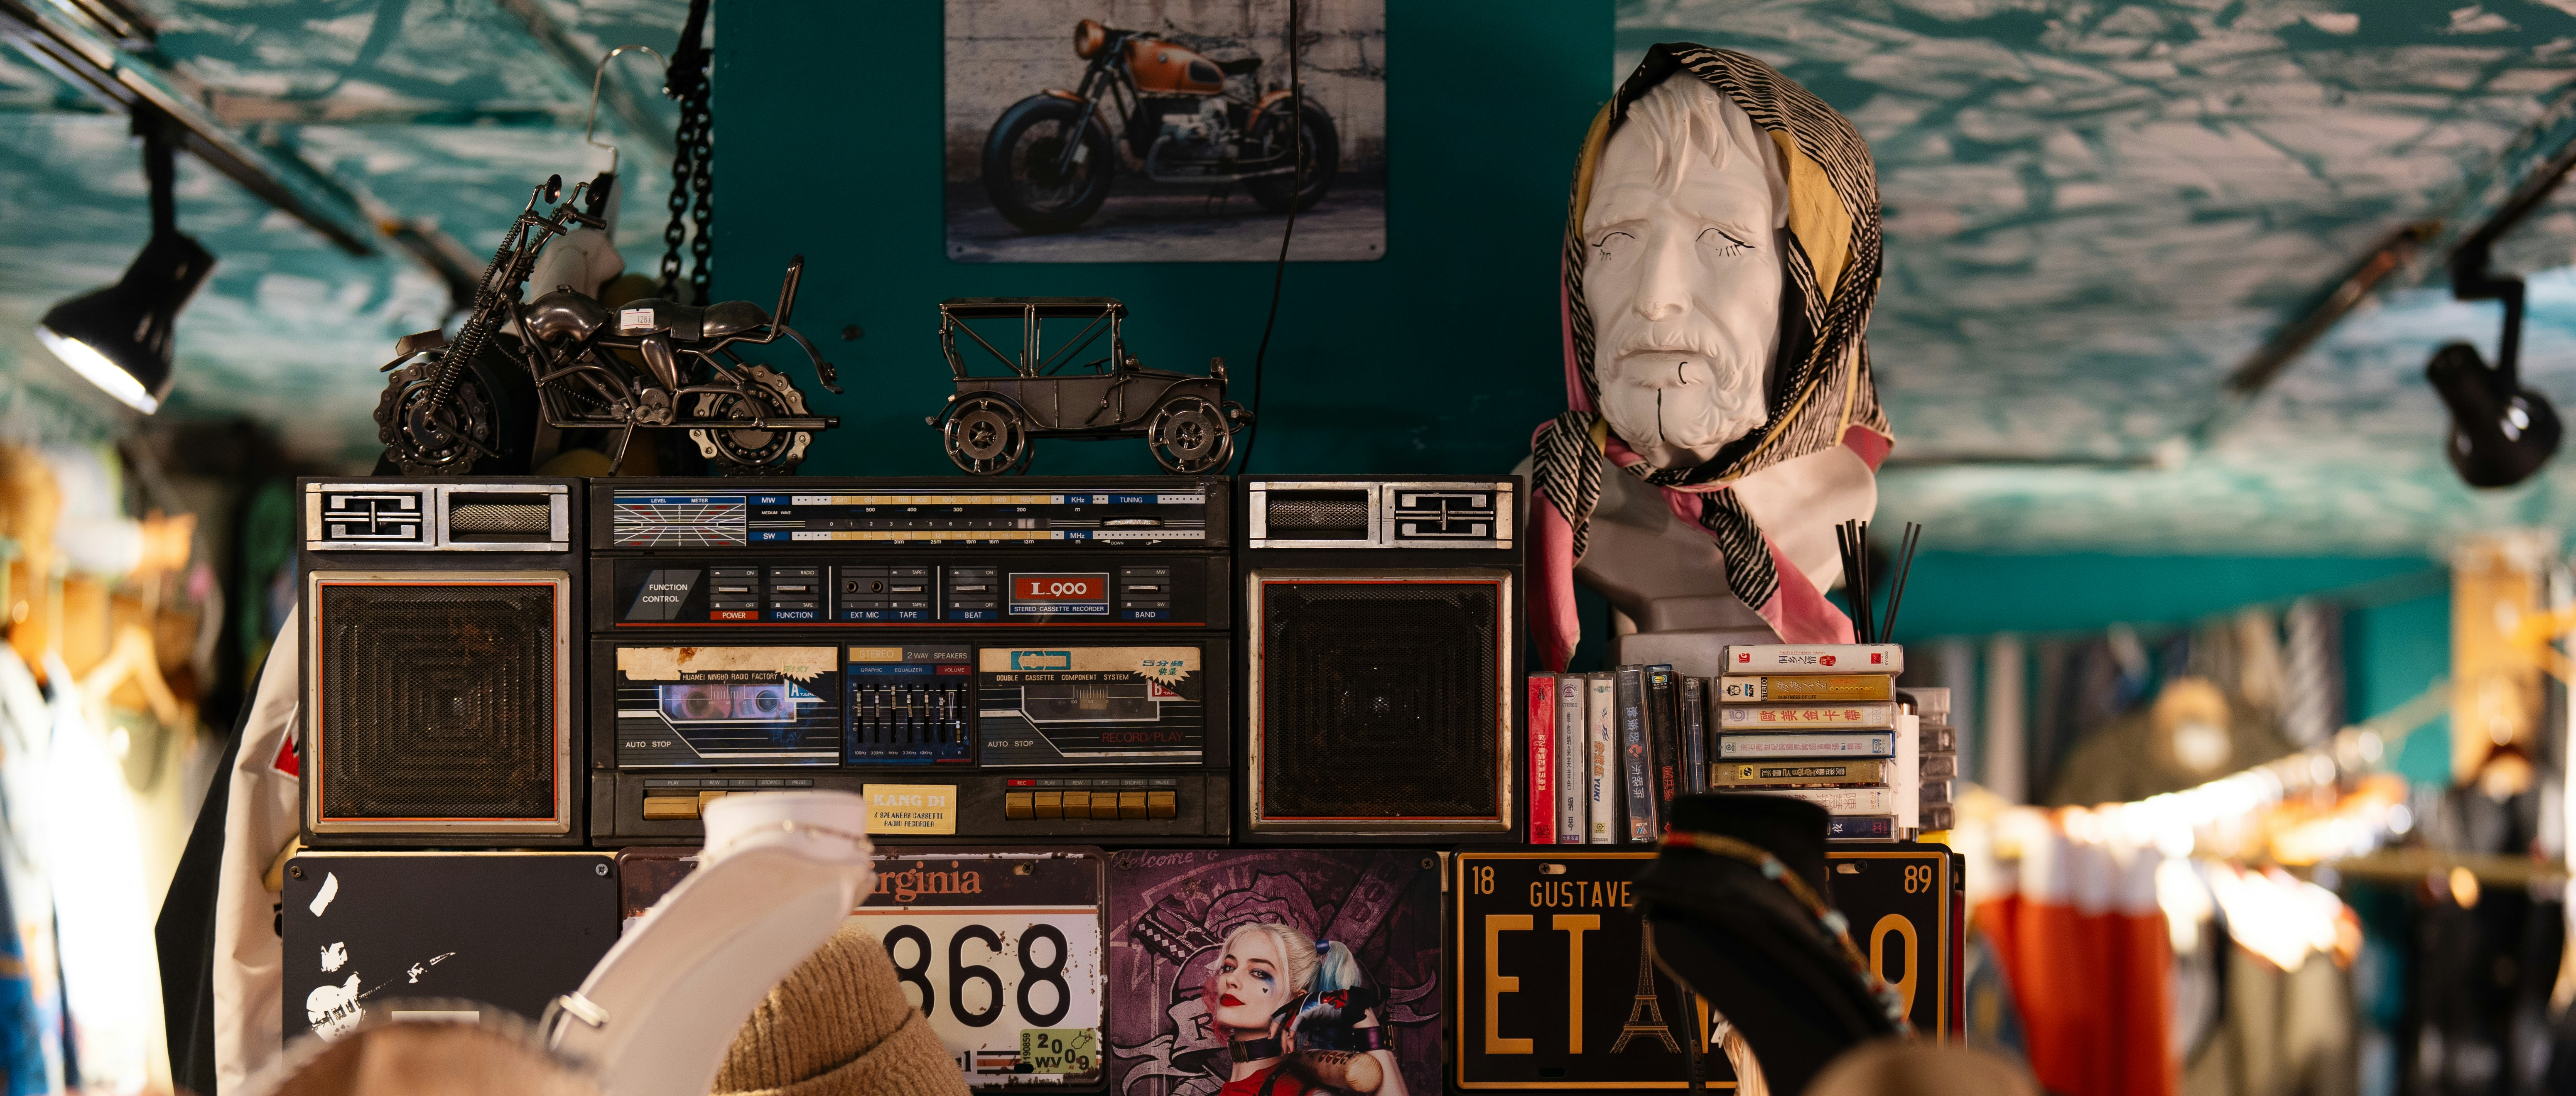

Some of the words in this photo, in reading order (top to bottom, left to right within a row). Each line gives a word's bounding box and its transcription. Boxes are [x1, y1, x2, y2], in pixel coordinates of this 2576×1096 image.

[859, 650, 894, 658] STEREO
[1158, 667, 1177, 676] 快录
[791, 683, 799, 696] A
[1872, 706, 1881, 726] STEREO
[772, 733, 802, 743] PLAY
[1102, 732, 1184, 743] RECORD/PLAY
[1793, 768, 1815, 777] Harlem
[873, 794, 922, 807] KANG
[928, 795, 945, 807] DI
[871, 861, 982, 902] irginia
[1473, 866, 1495, 895] 18
[1904, 865, 1932, 893] 89
[1530, 881, 1633, 908] GUSTAVE
